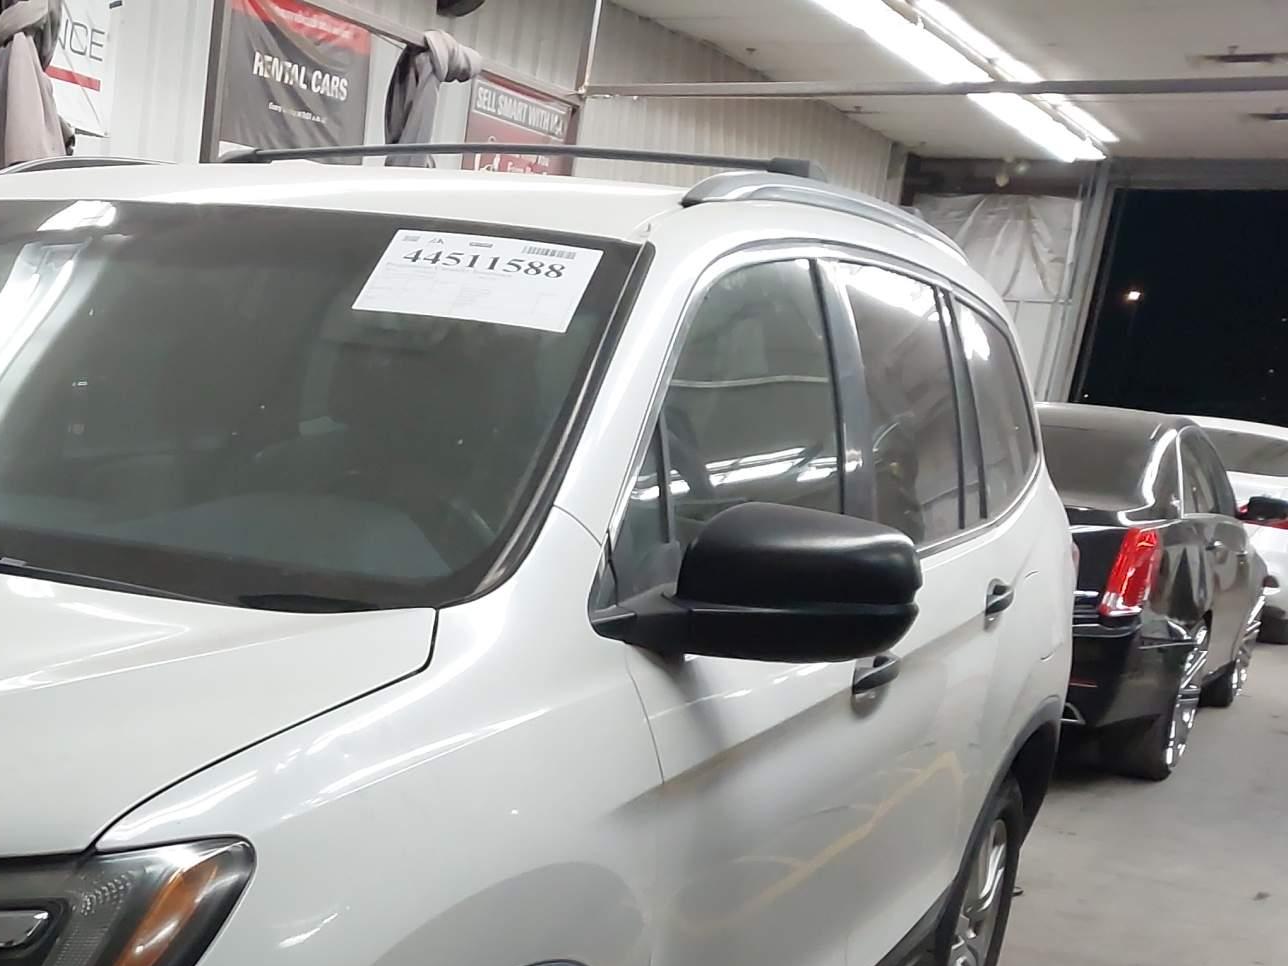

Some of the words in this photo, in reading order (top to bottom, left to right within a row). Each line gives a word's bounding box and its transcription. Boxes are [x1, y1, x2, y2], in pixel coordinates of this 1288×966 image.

[252, 51, 308, 90] RENTAL
[311, 70, 348, 101] CARS
[476, 86, 497, 113] SELL
[497, 94, 529, 123] SMART
[528, 105, 550, 132] WITH
[403, 249, 566, 279] 44511588
